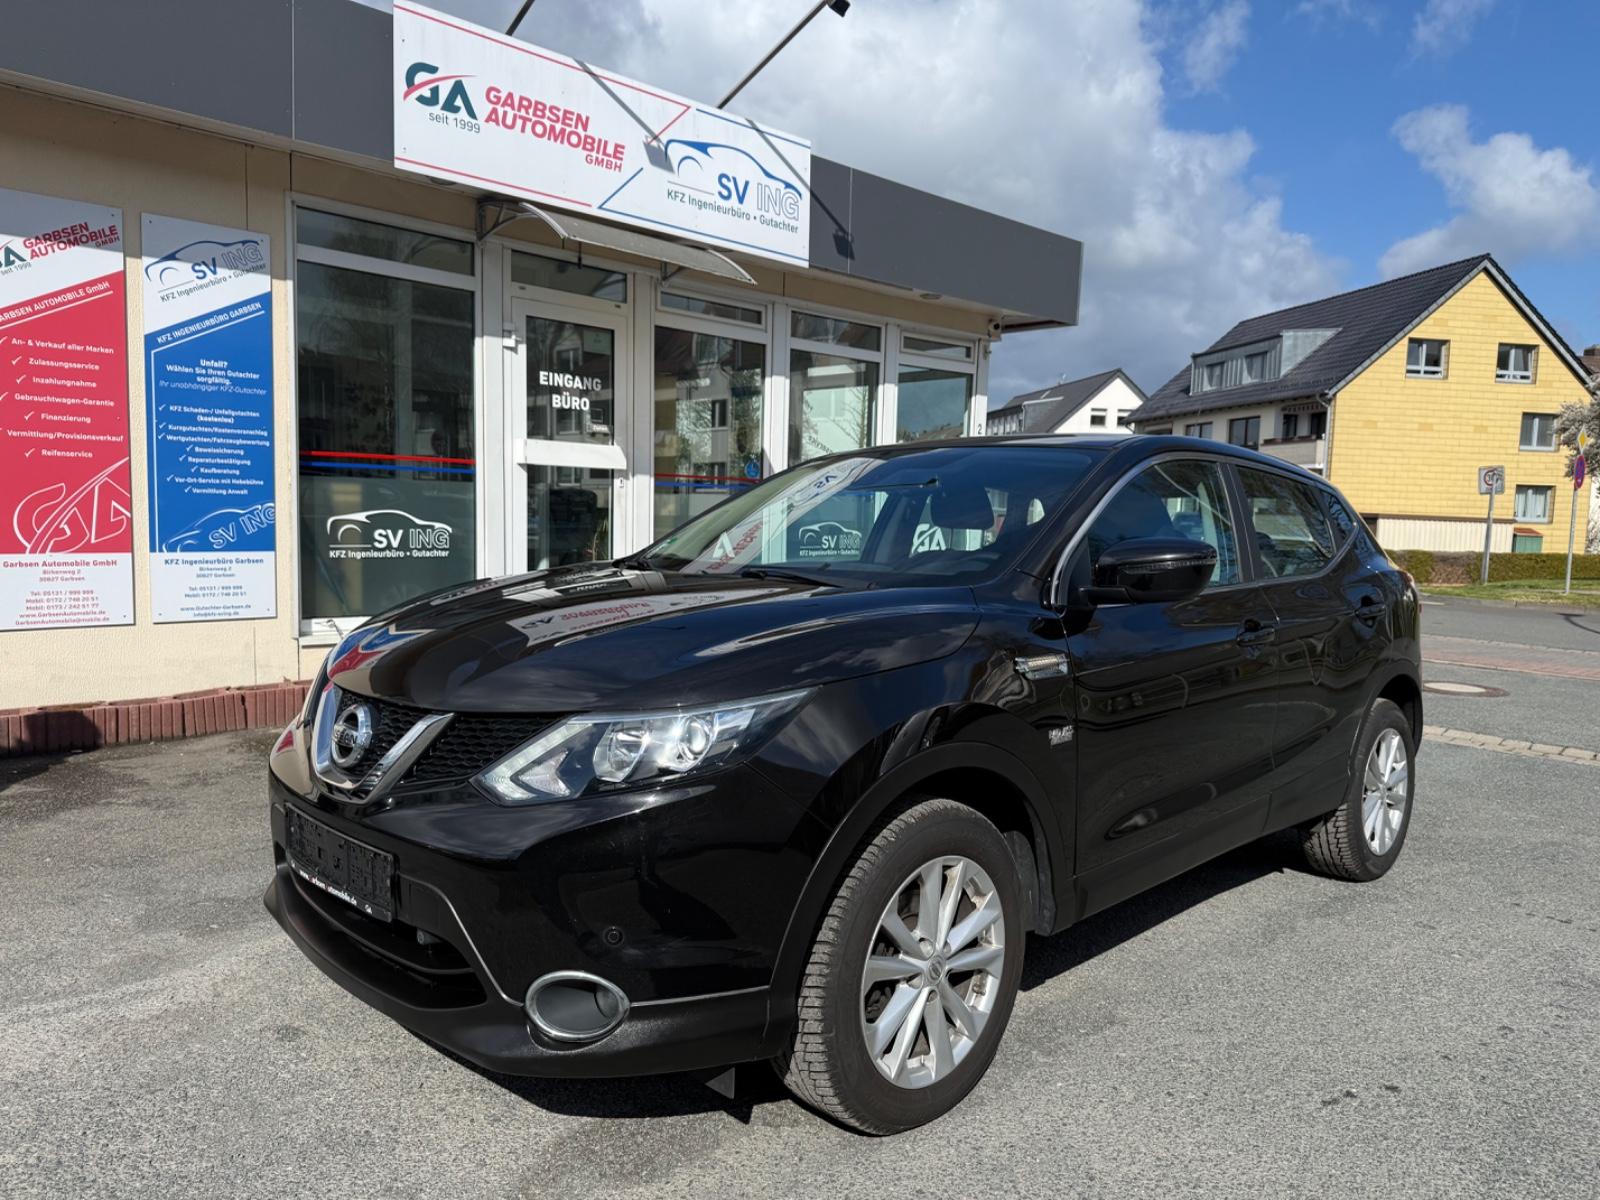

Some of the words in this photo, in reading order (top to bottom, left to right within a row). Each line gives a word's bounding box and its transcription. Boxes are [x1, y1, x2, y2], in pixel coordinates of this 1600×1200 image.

[404, 62, 478, 121] GA
[485, 86, 590, 132] GARBSEN
[429, 112, 449, 126] seit
[453, 118, 481, 134] 1999
[484, 109, 626, 162] AUTOMOBILE
[585, 154, 623, 173] GMBH
[717, 172, 750, 205] SV
[757, 182, 800, 221] ING
[667, 188, 686, 203] KFZ
[688, 194, 751, 221] Ingenieurbüro
[759, 214, 799, 234] Gutachter
[23, 221, 90, 249] GARBSEN
[30, 225, 119, 260] AUTOMOBILE
[95, 236, 120, 248] GMBH
[0, 245, 27, 268] A
[191, 257, 217, 280] SV
[221, 244, 263, 271] ING
[160, 292, 176, 303] KFZ
[177, 274, 227, 298] Ingenieurbüro
[0, 305, 33, 321] ARBSEN
[34, 288, 86, 311] AUTOMOBILE
[86, 281, 111, 294] GmbH
[230, 302, 262, 320] GARBSEN
[11, 337, 26, 345] An-
[35, 340, 66, 349] Verkauf
[67, 343, 85, 351] aller
[85, 345, 114, 354] Marken
[28, 357, 100, 371] Zulassungsservice
[166, 364, 194, 374] Wählen
[227, 370, 260, 380] Gutachter
[200, 359, 228, 368] Unfall?
[32, 376, 97, 388] Inzahlungnahme
[539, 371, 602, 391] EINGANG
[14, 392, 115, 408] Gebrauchtwagen-Garantie
[552, 391, 590, 411] BÜRO
[41, 412, 92, 424] Finanzierung
[7, 429, 124, 443] Vermittlung/Provisionsverkauf
[41, 448, 93, 458] Reifenservice
[208, 522, 238, 549] SV
[373, 529, 403, 549] SV
[409, 528, 450, 549] ING
[821, 535, 837, 549] SV
[3, 560, 39, 569] Garbsen
[41, 559, 91, 568] Automobile
[92, 558, 118, 567] GmbH
[164, 558, 180, 566] KFZ
[181, 558, 234, 567] Ingenieurbüro
[329, 550, 347, 559] KFZ
[348, 549, 404, 559] Ingenieurbüro
